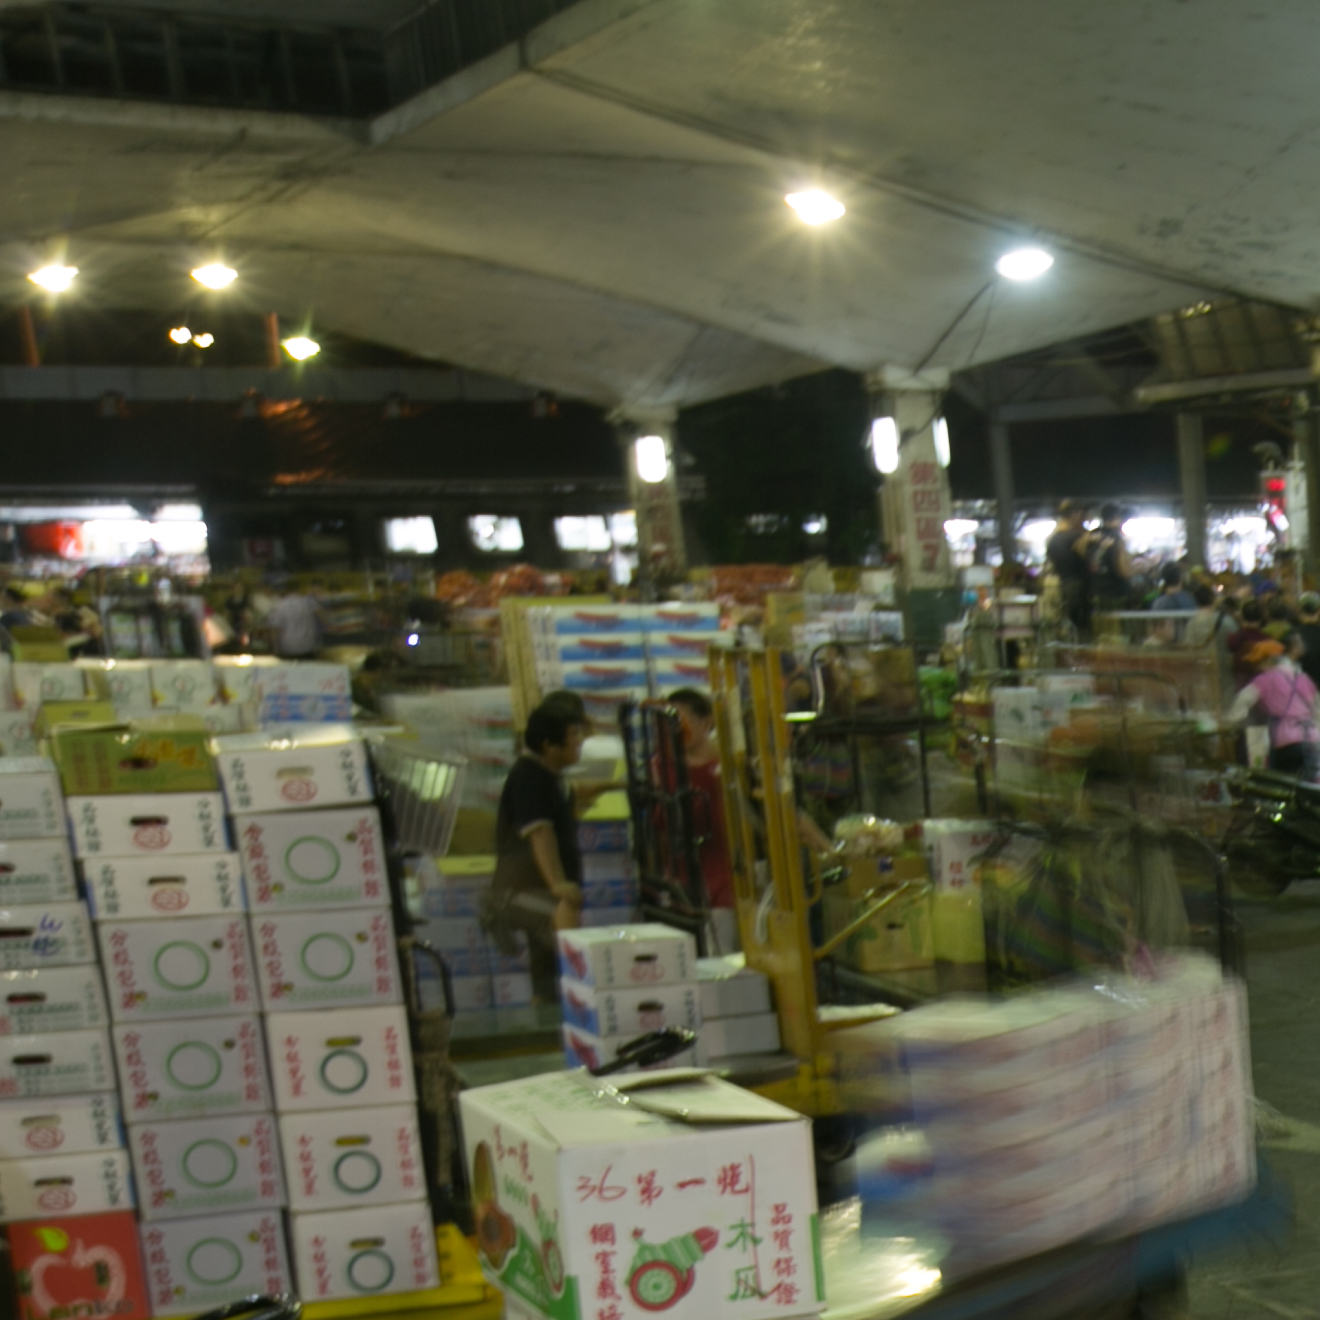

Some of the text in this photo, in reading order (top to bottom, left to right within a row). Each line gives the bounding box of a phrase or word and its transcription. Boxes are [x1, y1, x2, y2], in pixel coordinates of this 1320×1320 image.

[909, 461, 940, 574] 第四區7
[725, 1216, 764, 1301] 木瓜
[769, 1202, 801, 1306] 品質保證
